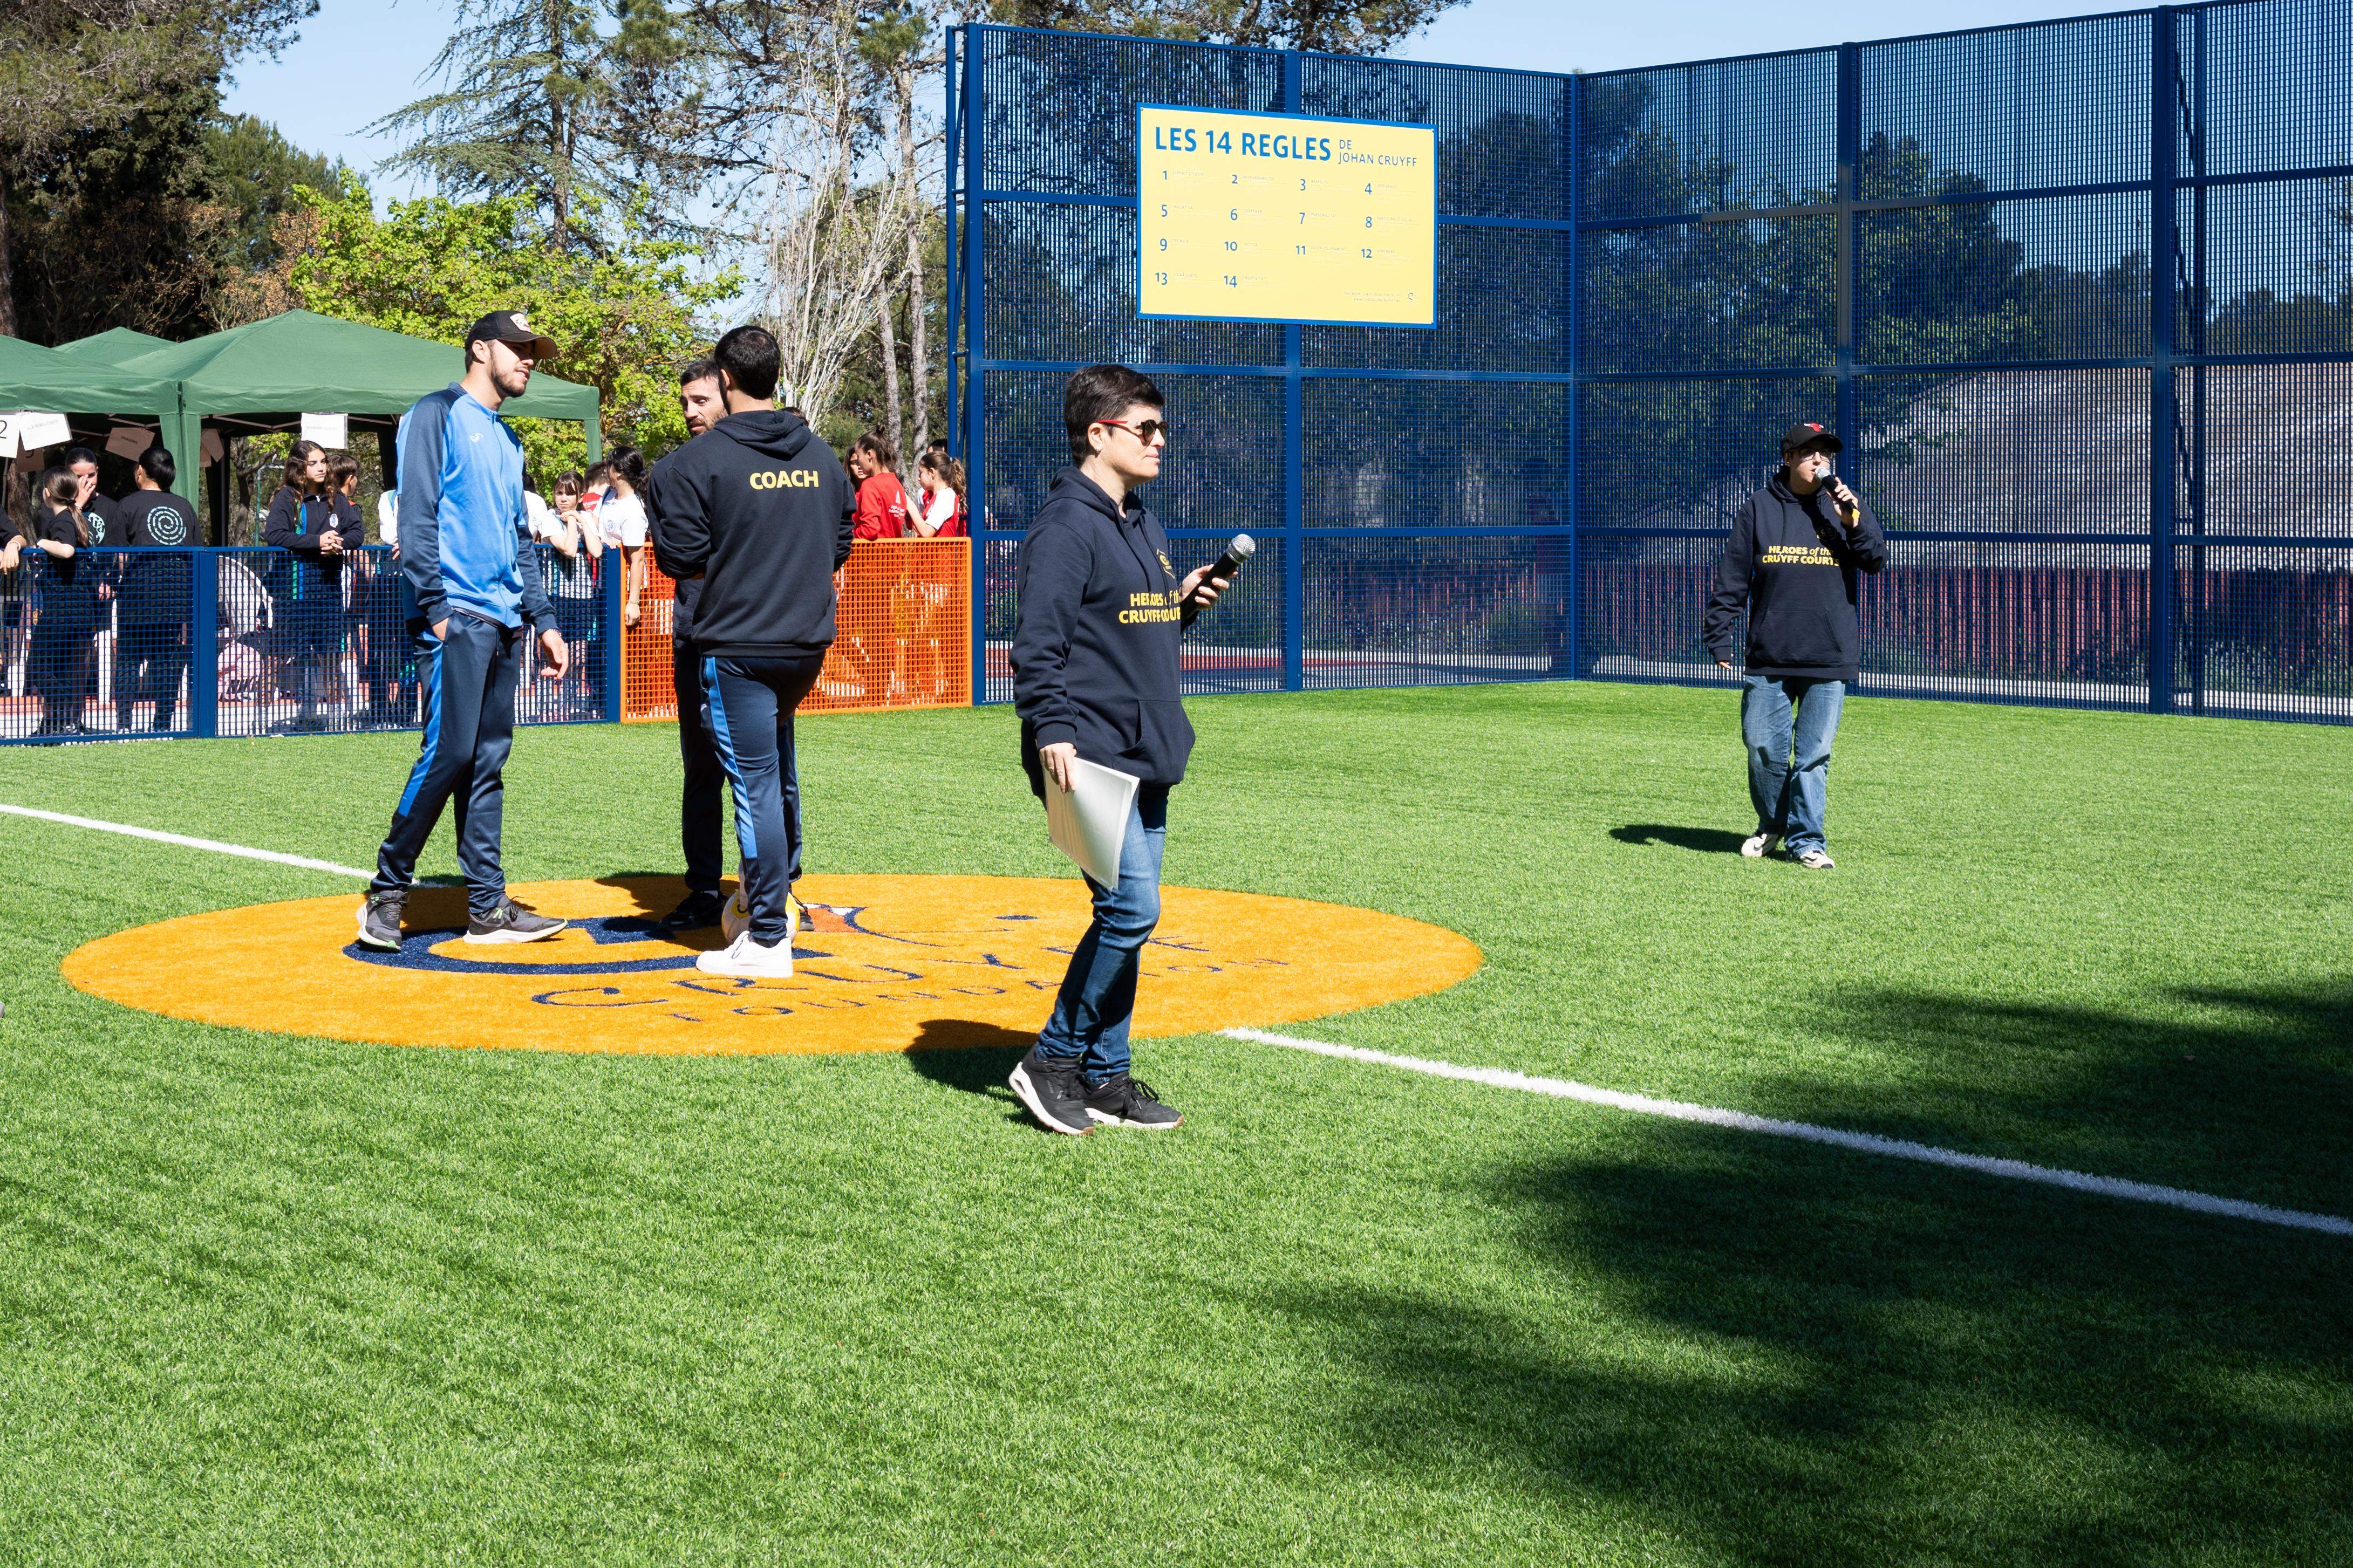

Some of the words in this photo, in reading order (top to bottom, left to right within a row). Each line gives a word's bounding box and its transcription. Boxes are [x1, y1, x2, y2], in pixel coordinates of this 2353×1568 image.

[1156, 126, 1197, 152] LES
[1206, 130, 1232, 154] 14
[1242, 132, 1332, 161] REGLES
[1339, 139, 1352, 150] DE
[1338, 152, 1374, 165] JOHAN
[1378, 155, 1417, 167] CRUYFF
[1162, 170, 1168, 180] 1
[1231, 174, 1238, 184] 2
[1300, 178, 1306, 191] 3
[1365, 183, 1373, 195] 4
[1161, 204, 1168, 217] 5
[1230, 208, 1238, 221] 6
[1299, 212, 1306, 225] 7
[1365, 216, 1373, 229] 8
[1160, 238, 1168, 251] 9
[1224, 241, 1238, 251] 10
[1295, 245, 1306, 256] 11
[1360, 248, 1373, 259] 12
[1155, 272, 1168, 285] 13
[1223, 275, 1238, 289] 14
[749, 470, 819, 490] COACH
[1769, 545, 1808, 555] HEROES
[1809, 547, 1820, 557] of
[1762, 554, 1799, 564] CRUYFF
[1118, 609, 1161, 624] CRUYFF
